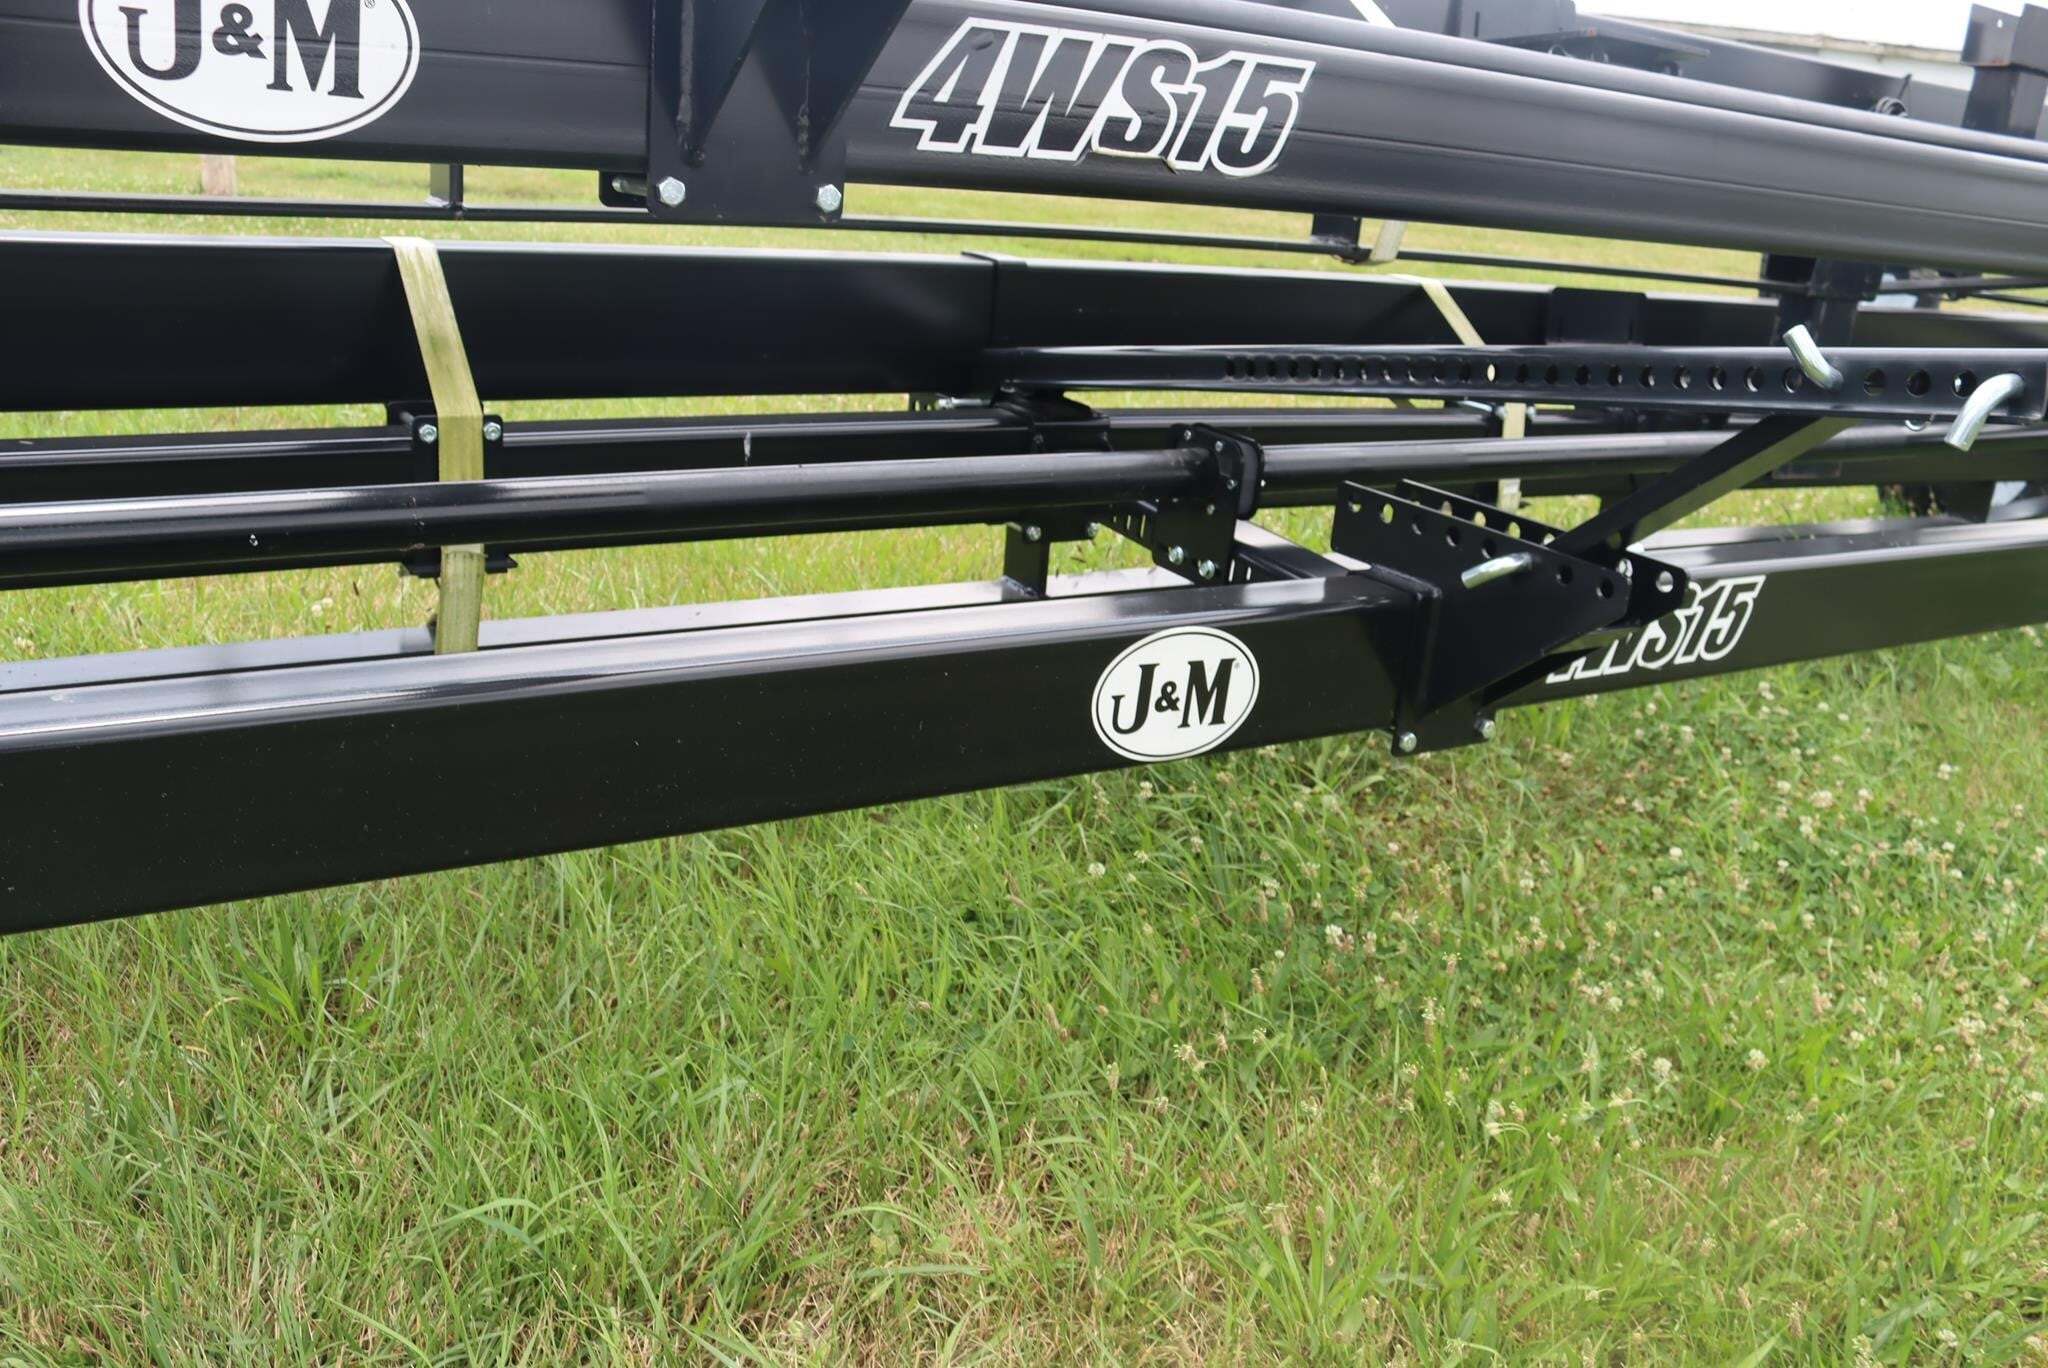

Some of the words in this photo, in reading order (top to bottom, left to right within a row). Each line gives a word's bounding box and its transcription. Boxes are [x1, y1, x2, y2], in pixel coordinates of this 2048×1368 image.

[118, 0, 365, 100] J&M
[889, 16, 1317, 178] 4WS15
[1545, 573, 1767, 684] S15
[1111, 657, 1237, 735] J&M
